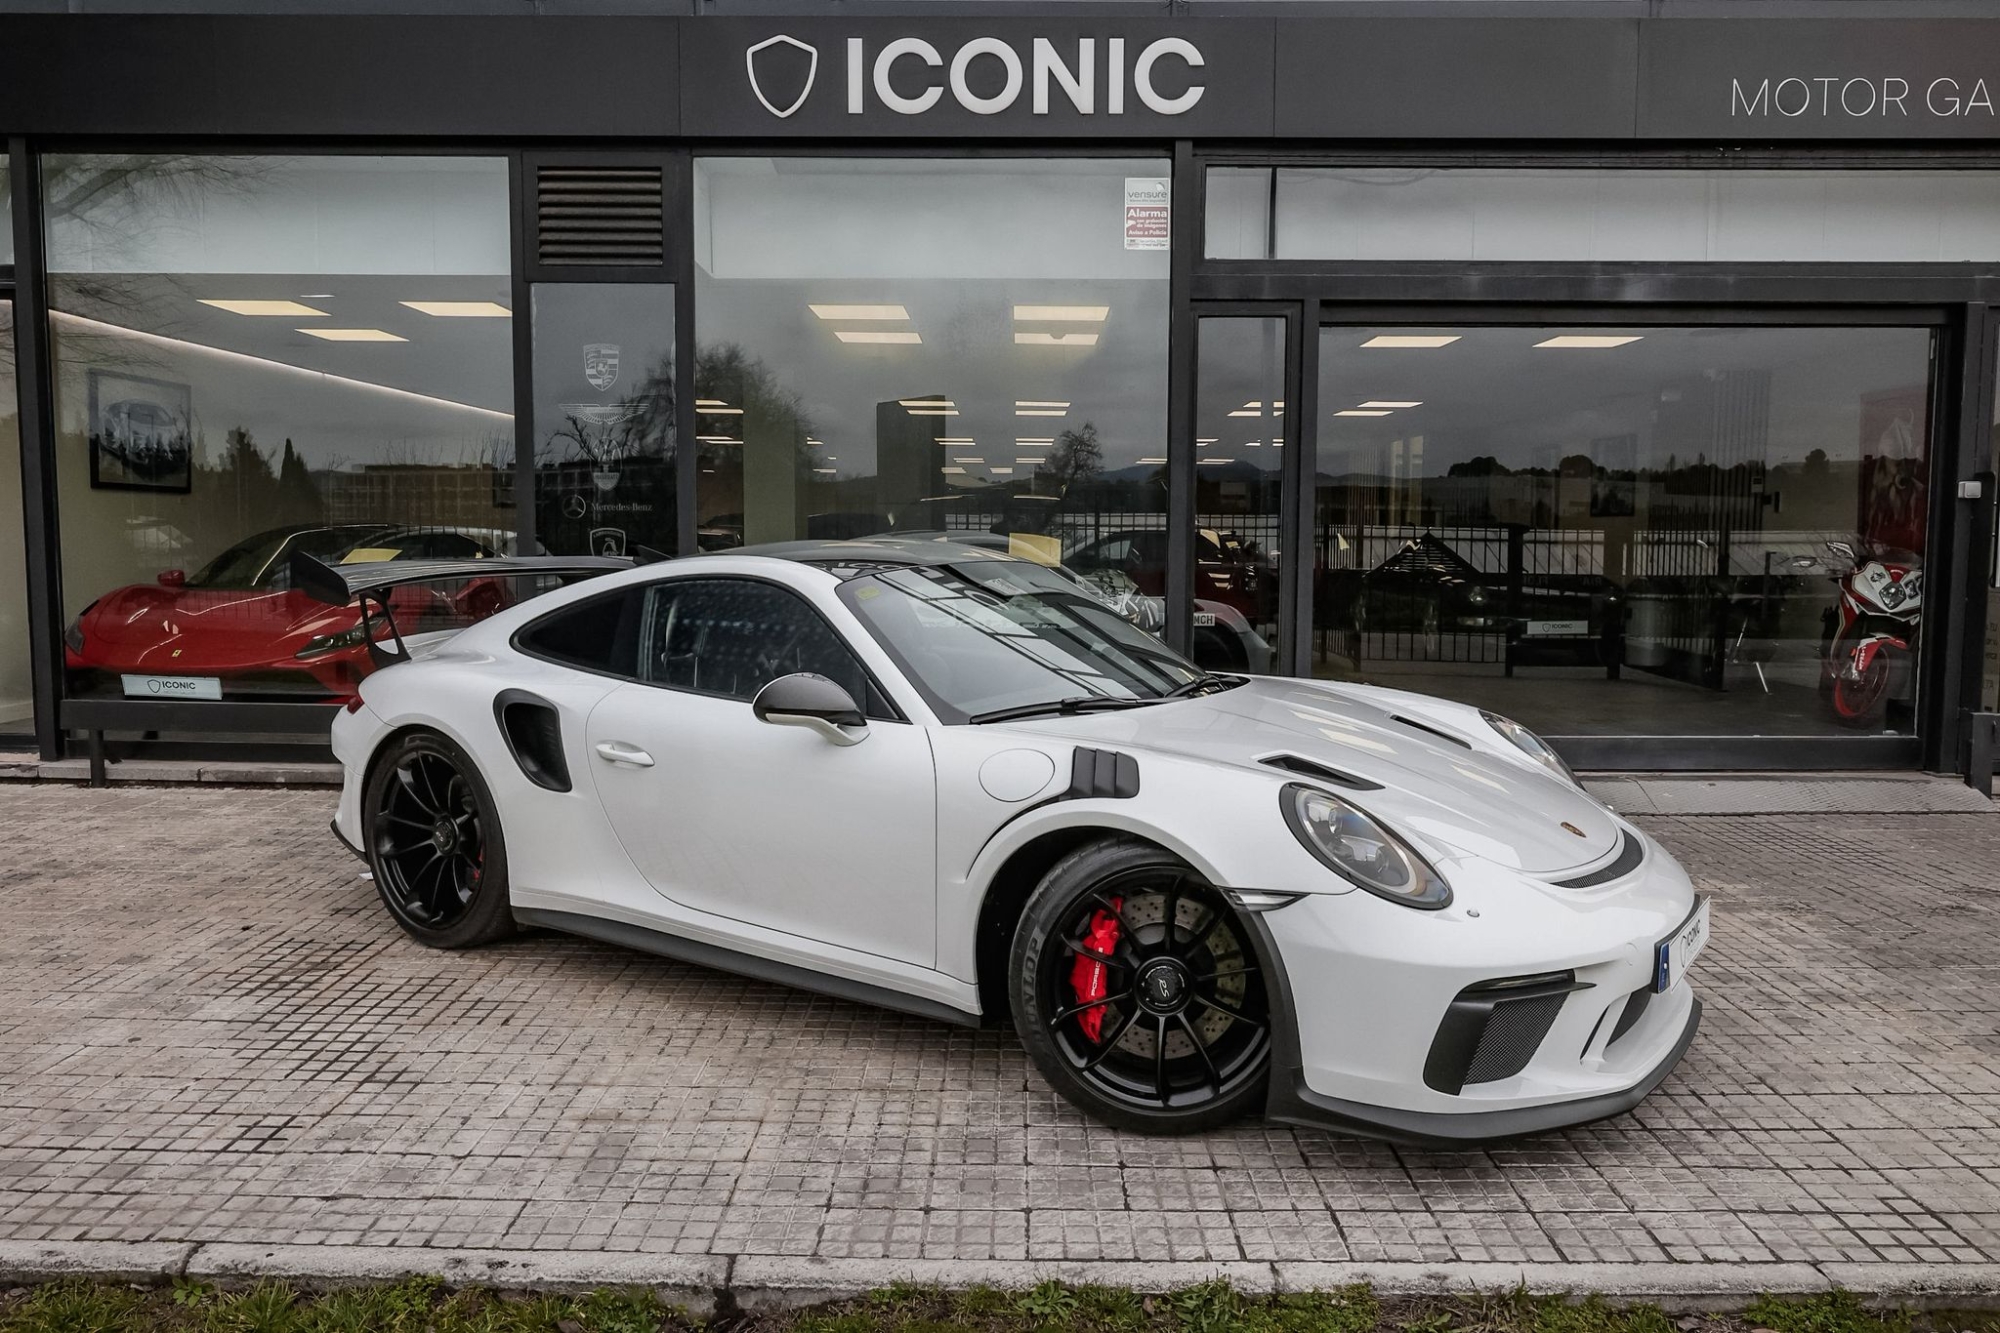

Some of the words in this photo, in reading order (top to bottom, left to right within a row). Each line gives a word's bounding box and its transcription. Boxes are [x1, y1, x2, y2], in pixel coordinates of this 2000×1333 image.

[847, 37, 1206, 115] ICONIC
[1731, 78, 1909, 116] MOTOR
[1128, 208, 1167, 217] Alarma
[591, 502, 653, 511] Mercedes-Benz
[162, 681, 196, 690] ICONIC
[1090, 947, 1104, 996] PORSCE
